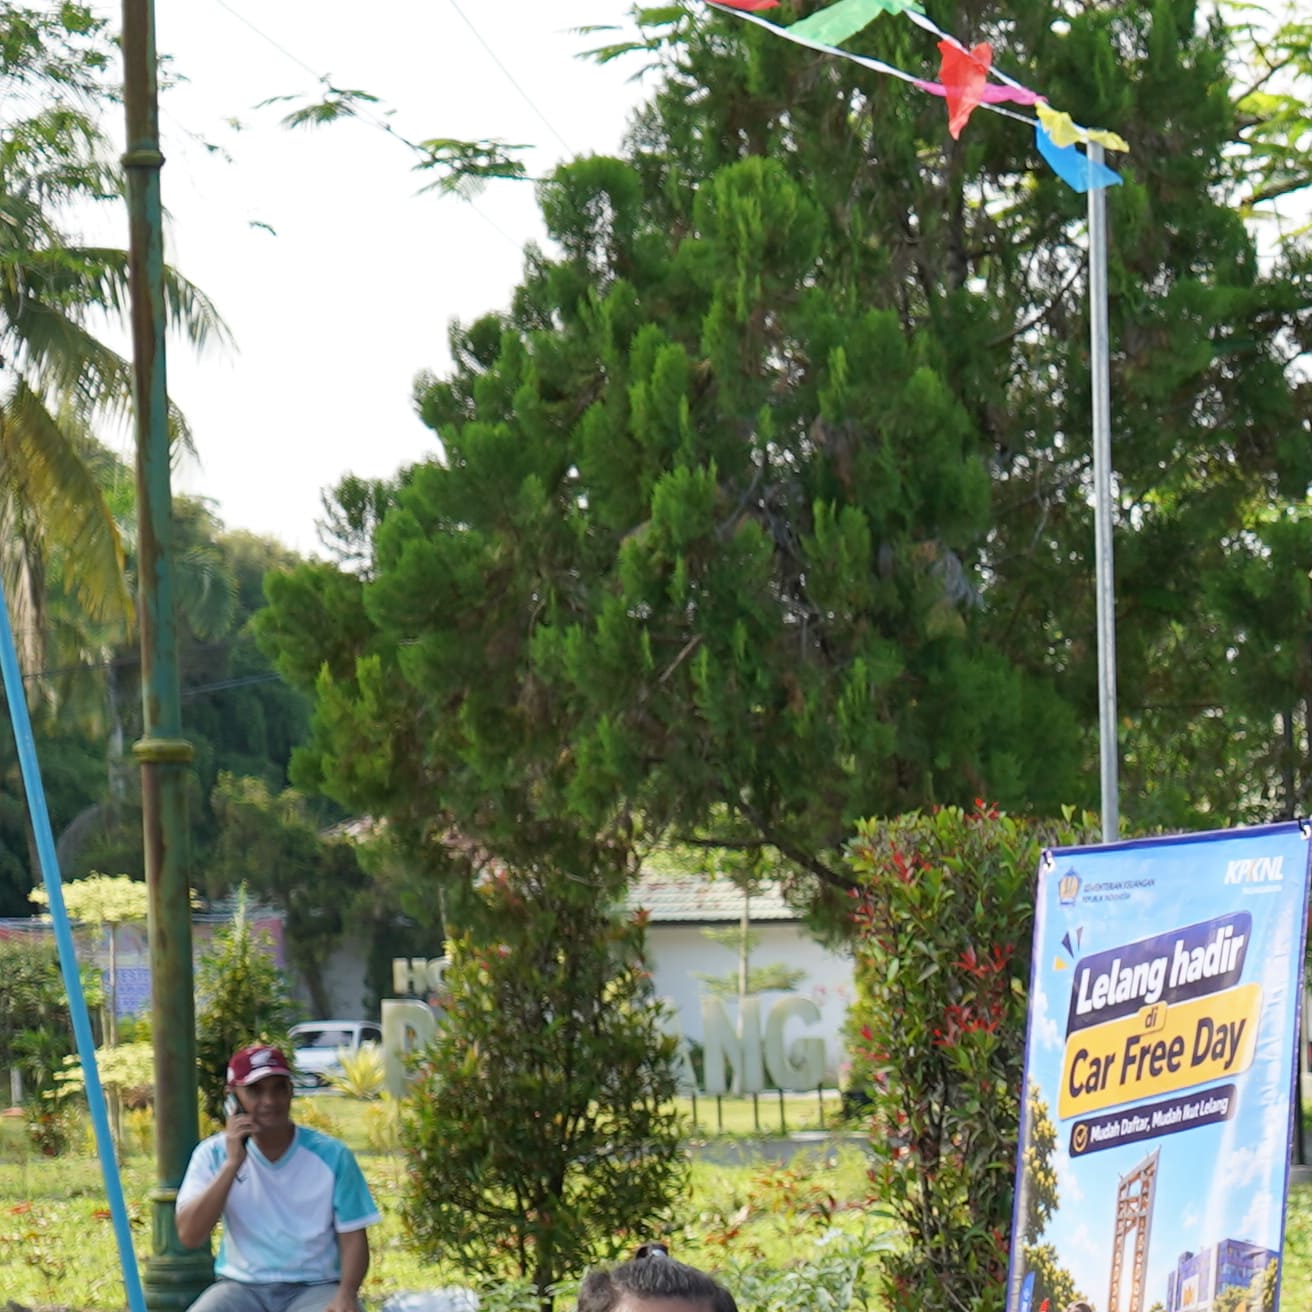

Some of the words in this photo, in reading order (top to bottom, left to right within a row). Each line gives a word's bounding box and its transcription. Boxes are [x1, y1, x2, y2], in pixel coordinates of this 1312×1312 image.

[1224, 856, 1284, 885] KPKNL
[1076, 954, 1164, 1015] Lelang
[1169, 924, 1246, 987] hadir
[1144, 1006, 1159, 1030] di
[1068, 1048, 1115, 1099] Car
[1120, 1034, 1184, 1085] Free
[1191, 1016, 1247, 1071] Day
[1090, 1120, 1120, 1142] Mudah
[1151, 1106, 1182, 1129] Mudah
[1199, 1097, 1229, 1116] Lelang
